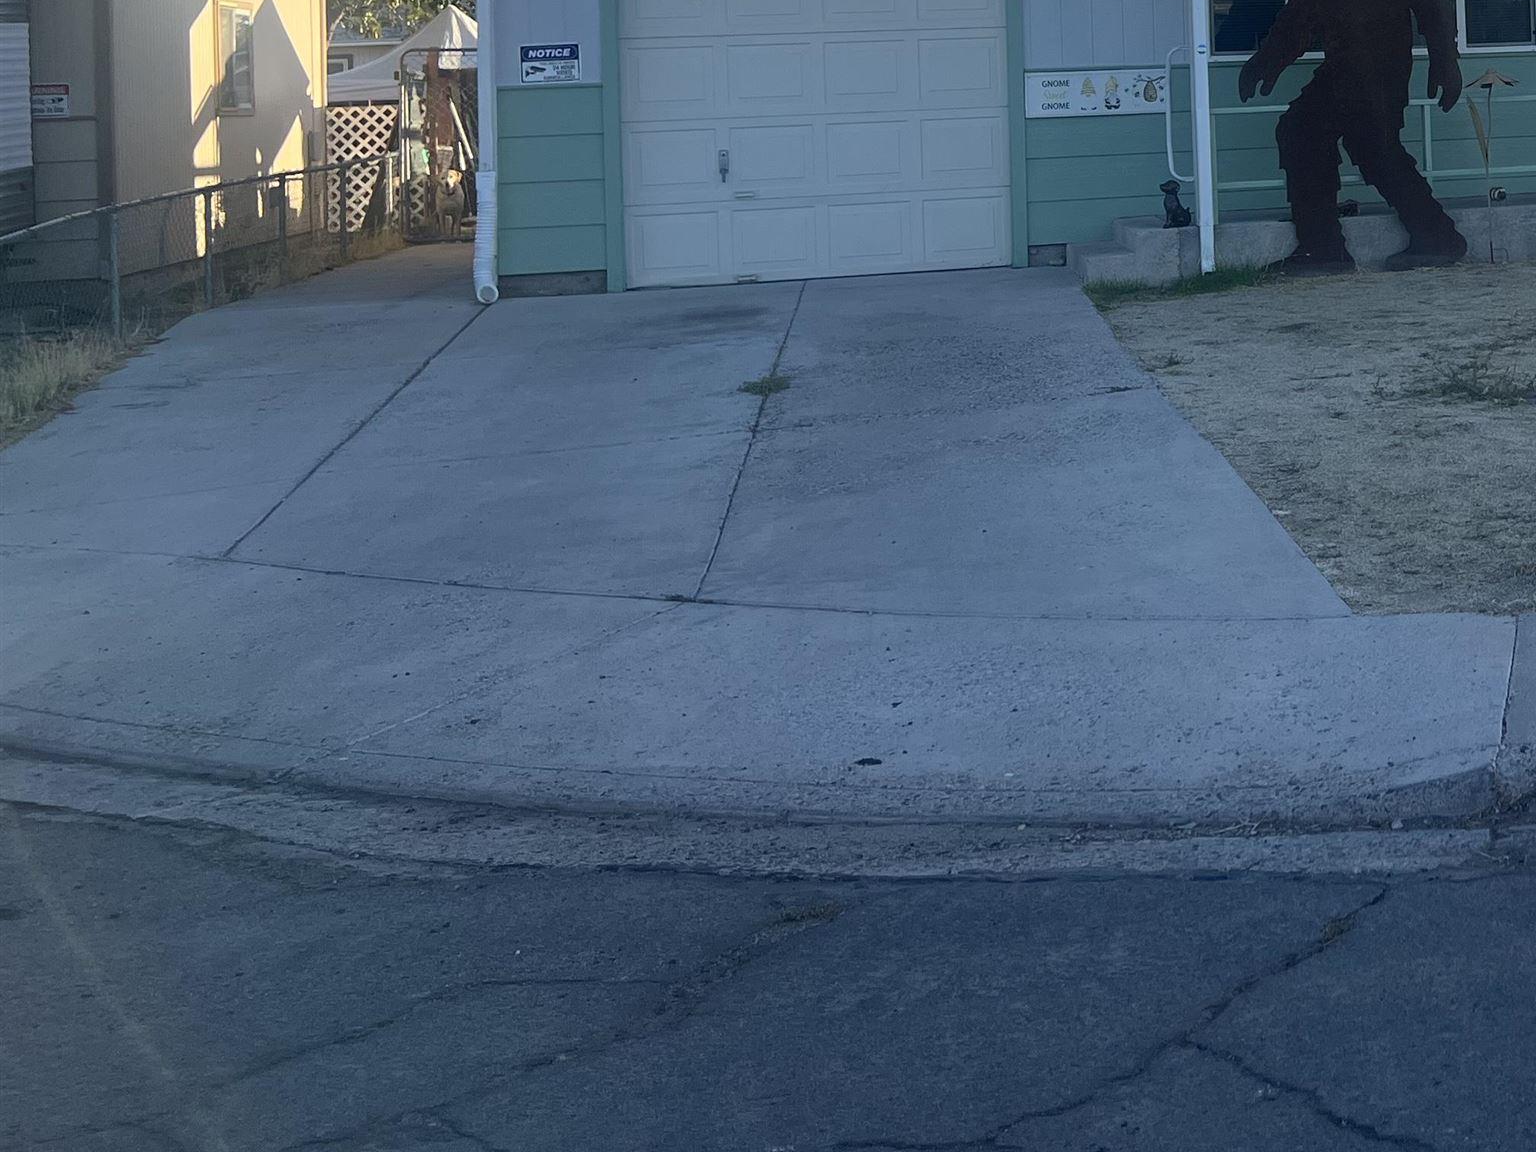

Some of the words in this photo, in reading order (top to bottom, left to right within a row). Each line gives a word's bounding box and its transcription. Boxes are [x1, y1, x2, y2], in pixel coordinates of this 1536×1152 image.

[528, 48, 571, 58] NOTICE
[1041, 80, 1070, 88] GNOME
[1041, 102, 1070, 110] GNOME
